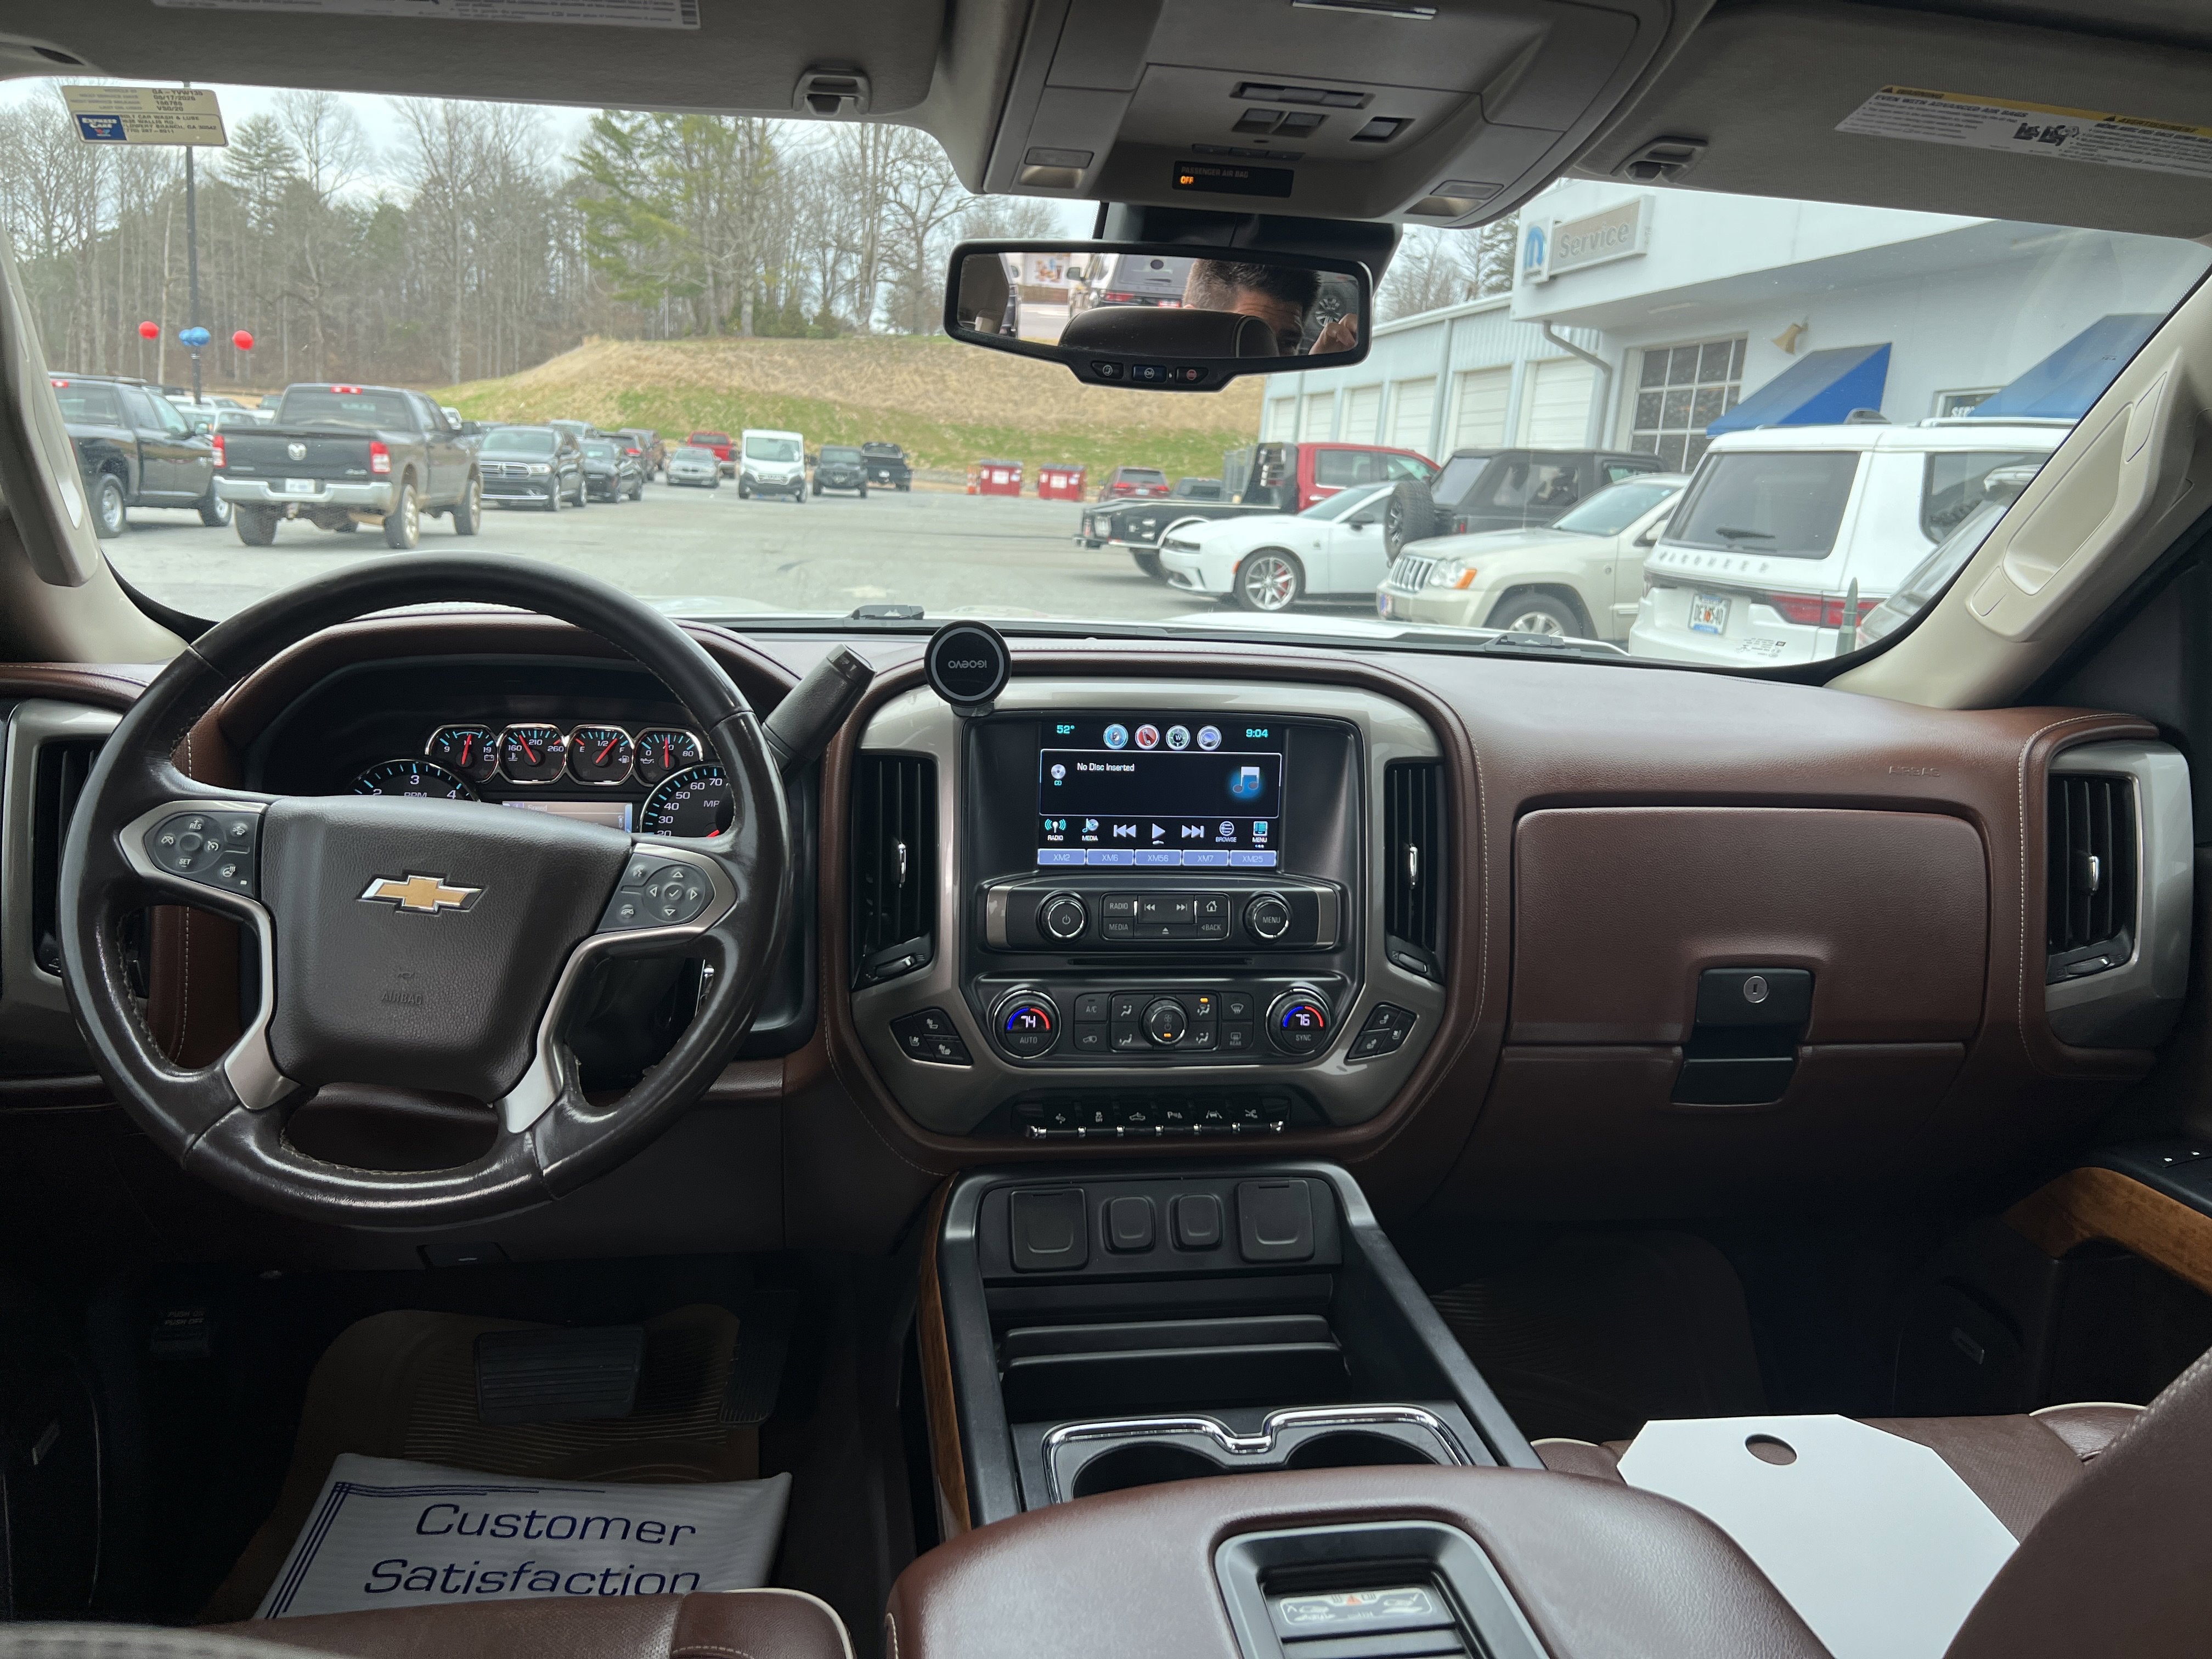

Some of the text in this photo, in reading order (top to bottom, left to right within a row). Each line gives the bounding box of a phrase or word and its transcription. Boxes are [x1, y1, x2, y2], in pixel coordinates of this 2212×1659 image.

[1181, 166, 1220, 176] PASSENGER
[1180, 175, 1194, 184] OFF
[1558, 222, 1629, 259] Service
[1246, 729, 1268, 738] 9:04
[1077, 763, 1135, 771] No Disc Inserted
[410, 775, 420, 785] 3
[709, 778, 723, 786] 70
[447, 789, 456, 799] 4
[381, 990, 423, 1005] AIRBAG
[1020, 1015, 1036, 1028] 74
[1295, 1014, 1310, 1026] 76
[415, 1503, 696, 1546] Customer
[364, 1559, 701, 1596] Satisfaction
